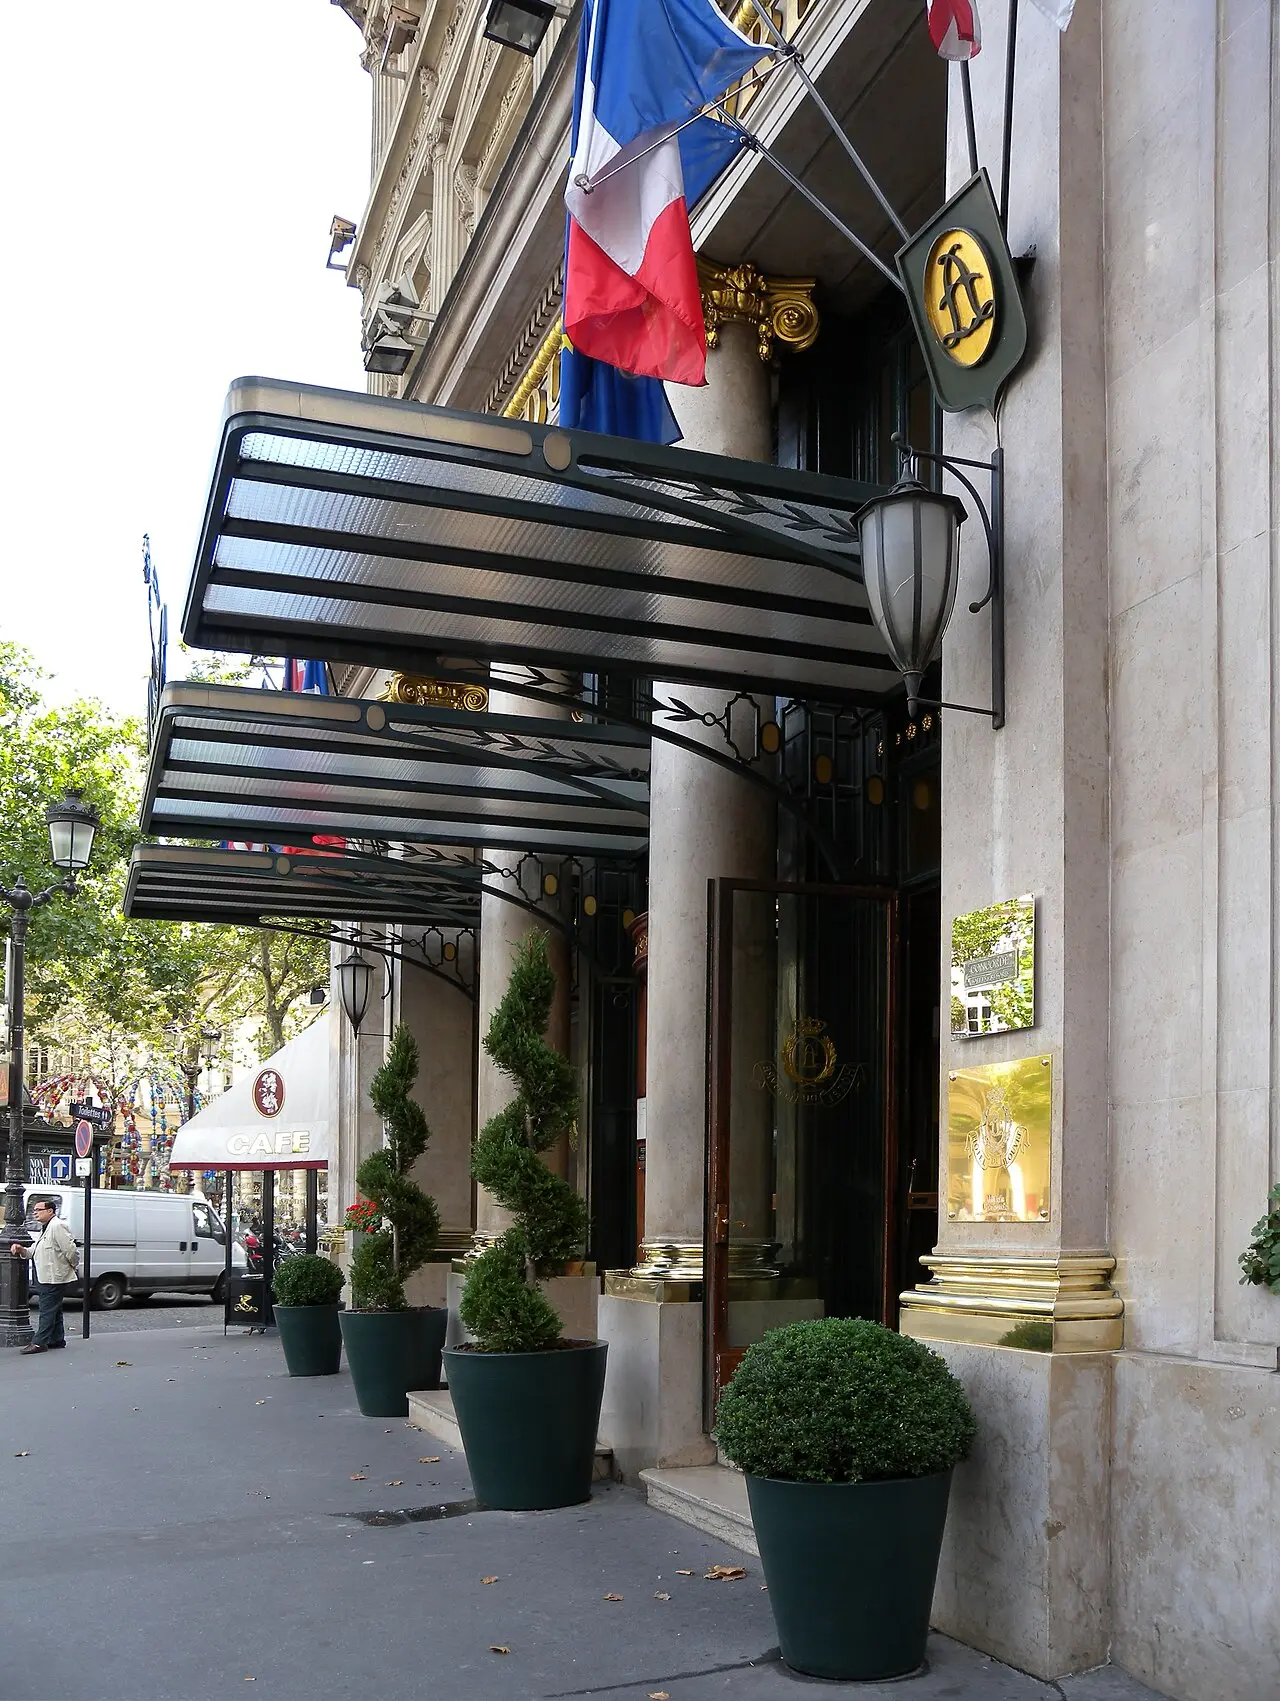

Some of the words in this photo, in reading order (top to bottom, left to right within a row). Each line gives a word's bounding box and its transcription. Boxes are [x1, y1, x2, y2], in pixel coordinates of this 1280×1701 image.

[79, 1105, 101, 1119] Toilettes
[227, 1130, 311, 1155] CAFE
[30, 1158, 44, 1169] NON
